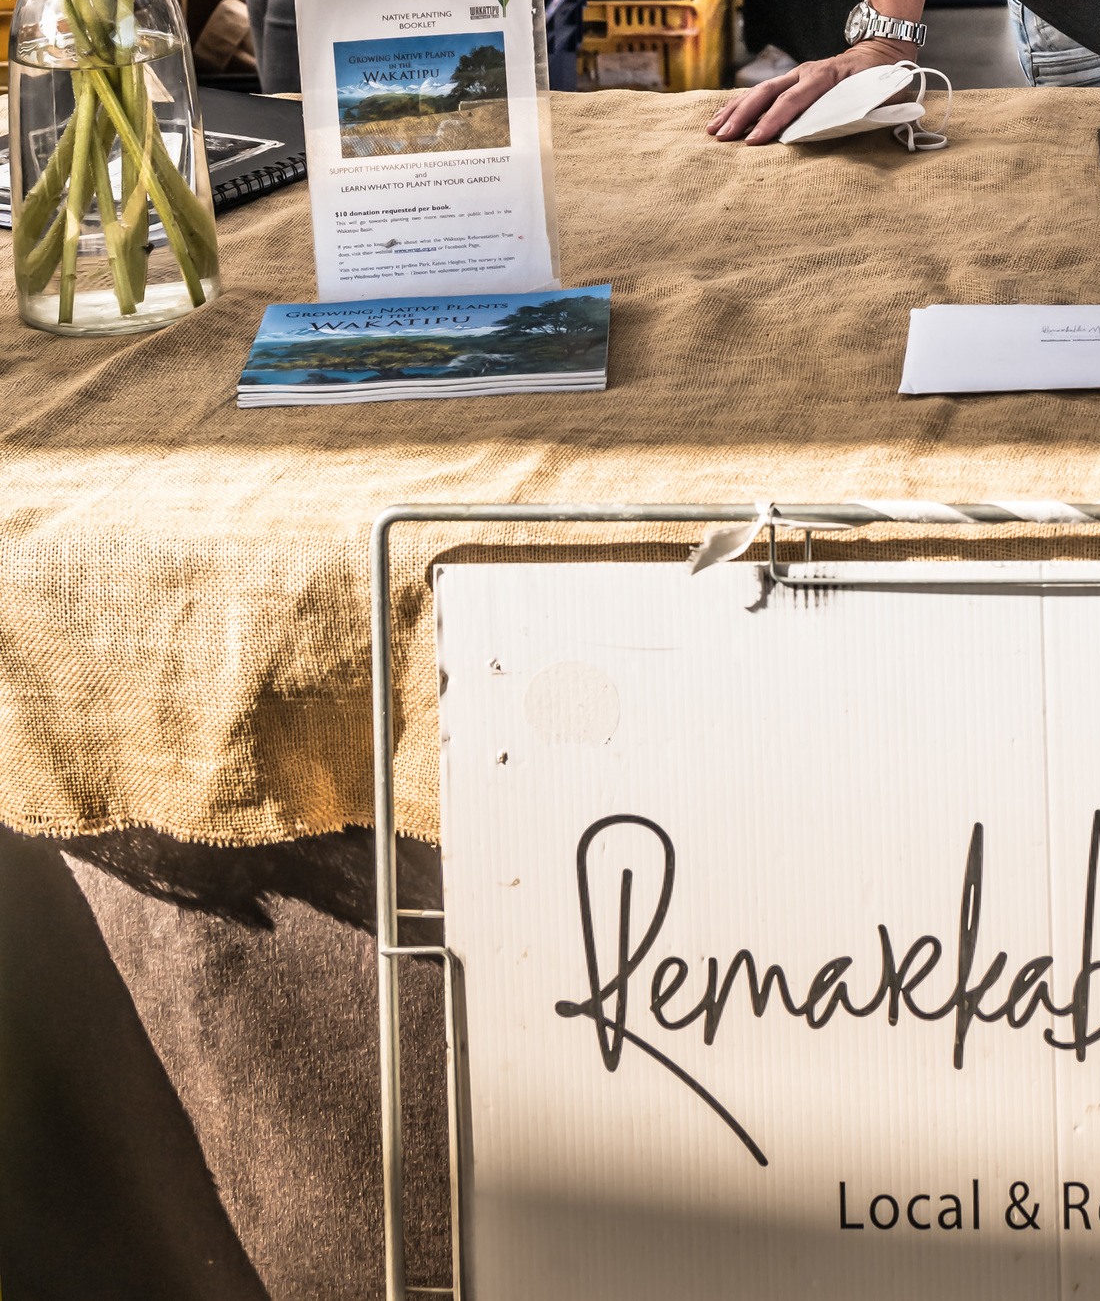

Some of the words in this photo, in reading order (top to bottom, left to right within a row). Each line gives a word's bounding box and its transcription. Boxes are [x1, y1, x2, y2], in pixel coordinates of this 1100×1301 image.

[382, 12, 410, 22] NATIVE
[411, 11, 452, 20] PLANTING
[469, 5, 499, 16] WAKATIPU
[399, 21, 435, 29] BOOKLET
[363, 68, 440, 83] WAKATIPU
[330, 166, 363, 175] SUPPORT
[365, 164, 380, 172] THE
[381, 162, 422, 171] WAKATIPU
[424, 158, 486, 169] REFORESTATION
[486, 156, 510, 164] TRUST
[341, 184, 367, 193] LEARN
[367, 183, 391, 191] WHAT
[406, 180, 431, 188] PLANT
[441, 178, 464, 186] YOUR
[349, 209, 380, 217] donation
[382, 206, 416, 215] requested
[418, 205, 430, 213] per
[285, 309, 376, 319] GROWING
[380, 304, 440, 314] NATIVE
[447, 302, 508, 311] PLANTS
[309, 316, 470, 332] WAKATIPU
[836, 1178, 983, 1237] Local
[1005, 1180, 1043, 1234] &
